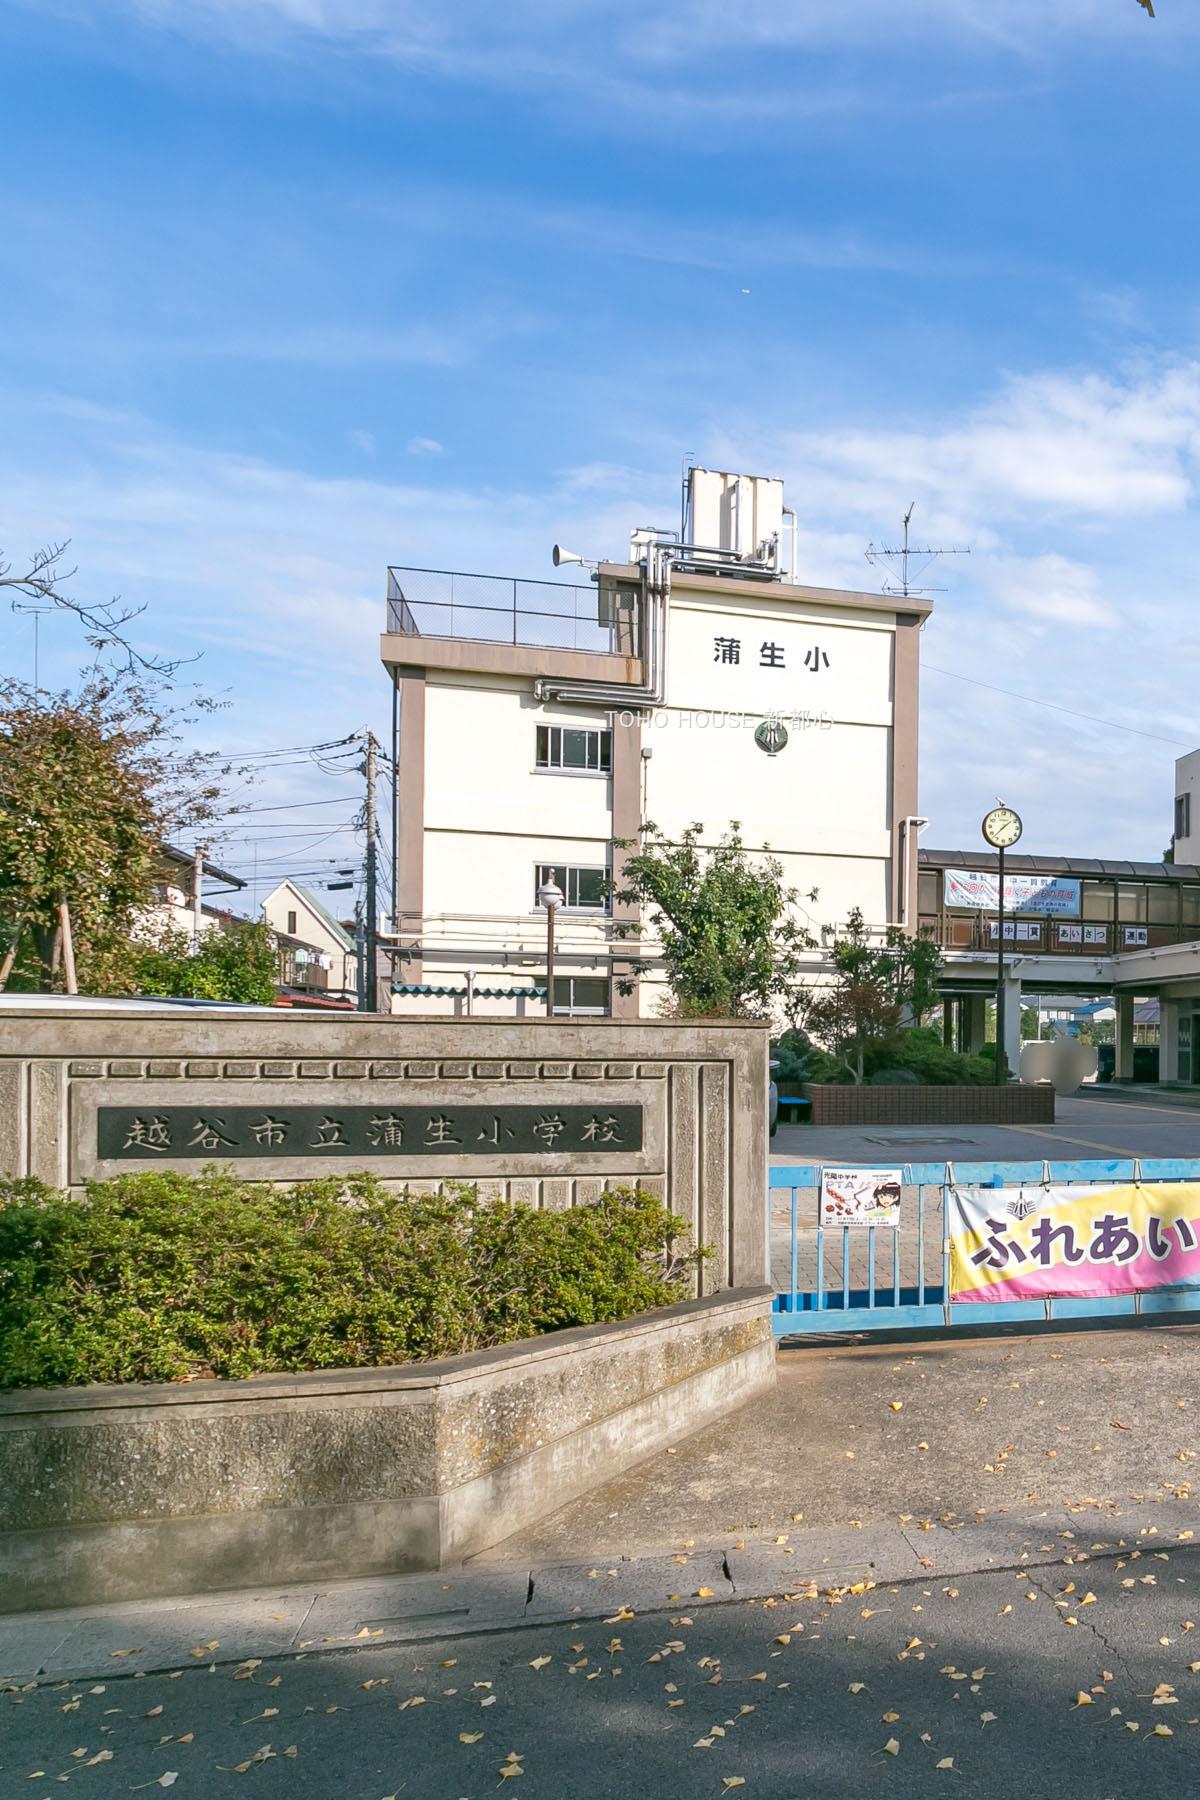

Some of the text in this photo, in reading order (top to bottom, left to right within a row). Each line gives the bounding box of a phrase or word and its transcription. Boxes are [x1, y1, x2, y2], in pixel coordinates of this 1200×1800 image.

[713, 637, 830, 672] 蒲生小
[1060, 927, 1105, 939] あいさつ
[1127, 929, 1147, 941] 運動
[122, 1113, 627, 1151] 越谷市立蒲生小学校
[970, 1212, 1199, 1271] ふれあい
